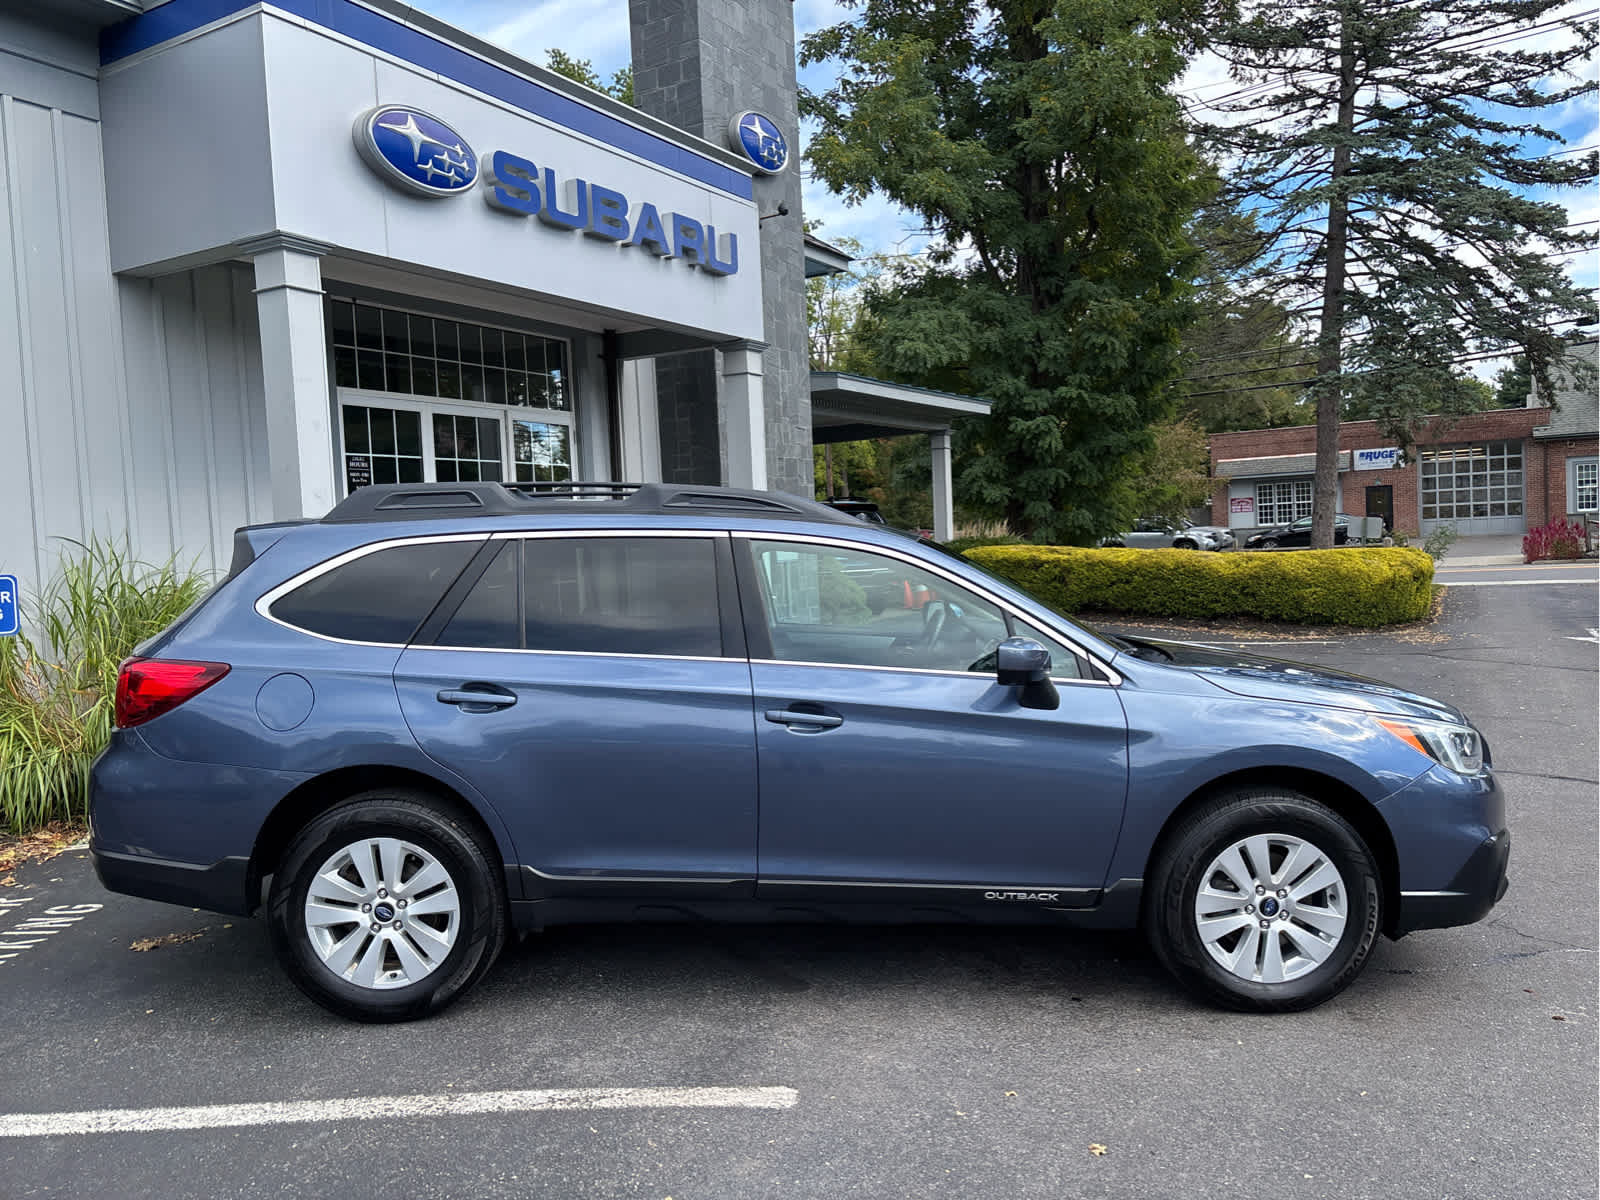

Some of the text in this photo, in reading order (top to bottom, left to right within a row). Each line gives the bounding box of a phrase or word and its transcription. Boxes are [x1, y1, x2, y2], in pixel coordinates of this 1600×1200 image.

[486, 150, 738, 275] SUBARU
[1365, 449, 1397, 461] RUGE
[984, 891, 1060, 901] OUTBACK
[0, 904, 104, 965] KING
